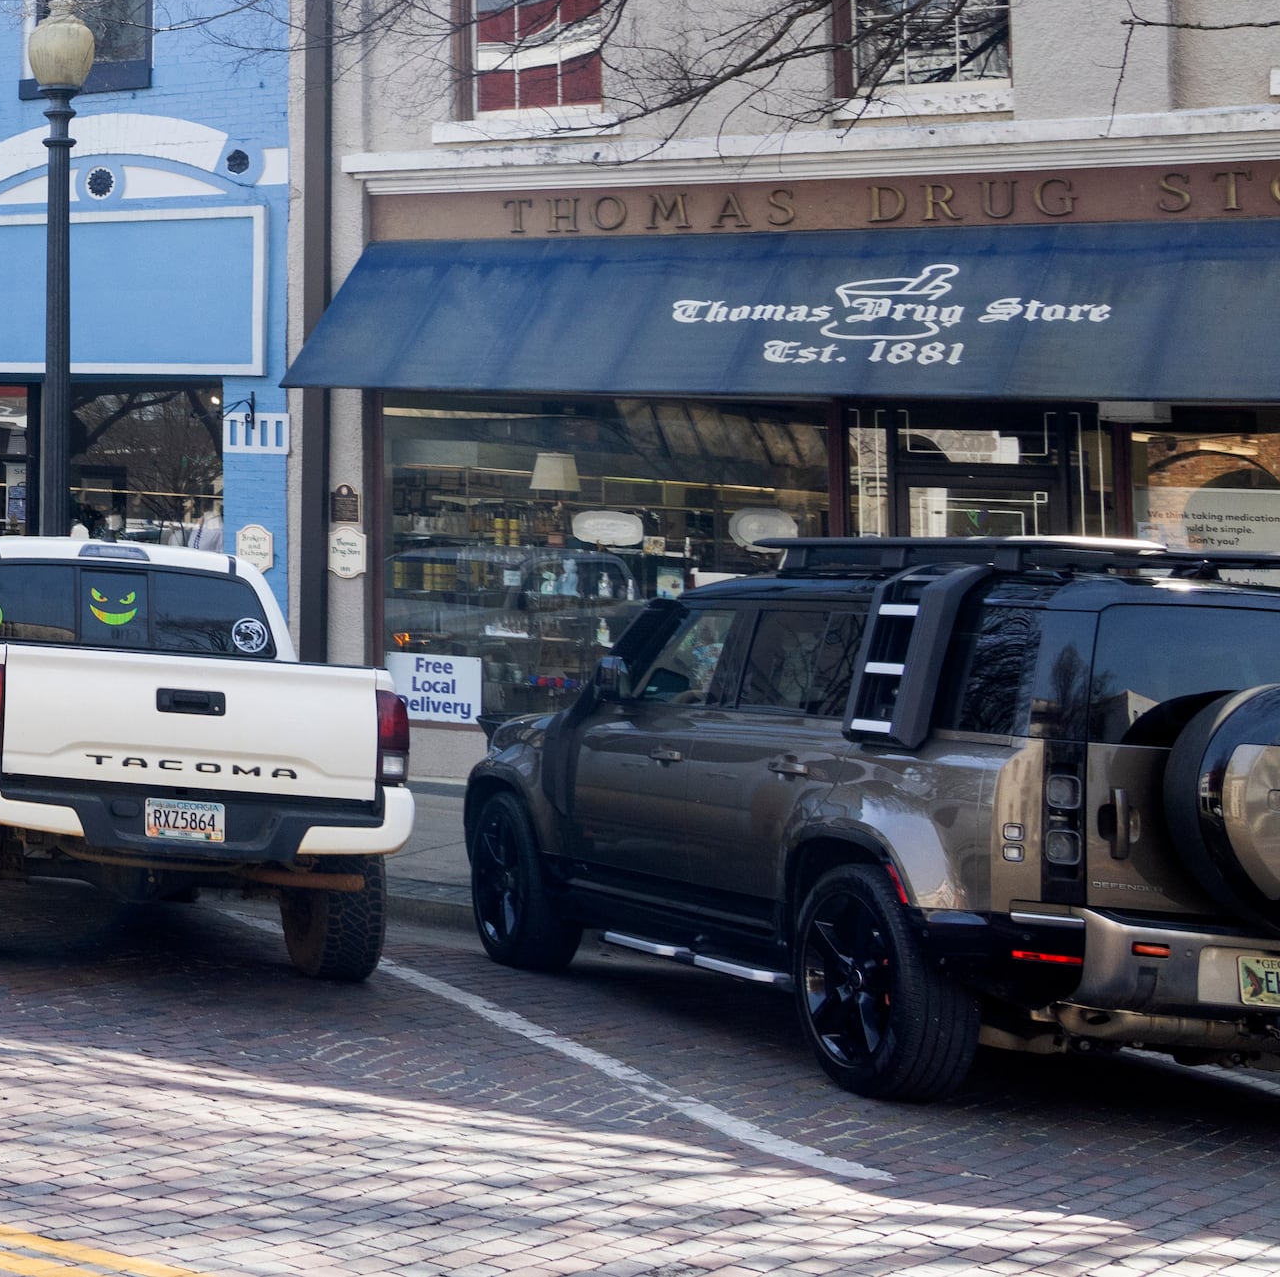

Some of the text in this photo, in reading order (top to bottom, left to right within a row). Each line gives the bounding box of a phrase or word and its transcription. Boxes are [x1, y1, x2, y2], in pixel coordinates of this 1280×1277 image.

[503, 167, 1280, 234] THOMAS DRUG ST
[672, 297, 1112, 327] Thomas Drug Store
[763, 339, 965, 365] Est. 1881
[1147, 510, 1280, 523] We think taking medication
[242, 533, 267, 542] Brokers
[1206, 525, 1218, 533] be
[1220, 525, 1255, 536] simple.
[1188, 535, 1241, 547] Don't you?
[239, 549, 269, 559] Exchange
[415, 657, 454, 675] Free
[411, 675, 457, 695] Local
[85, 753, 298, 780] TACOMA
[176, 801, 220, 813] GEORGIA
[153, 808, 216, 832] RXZ5864
